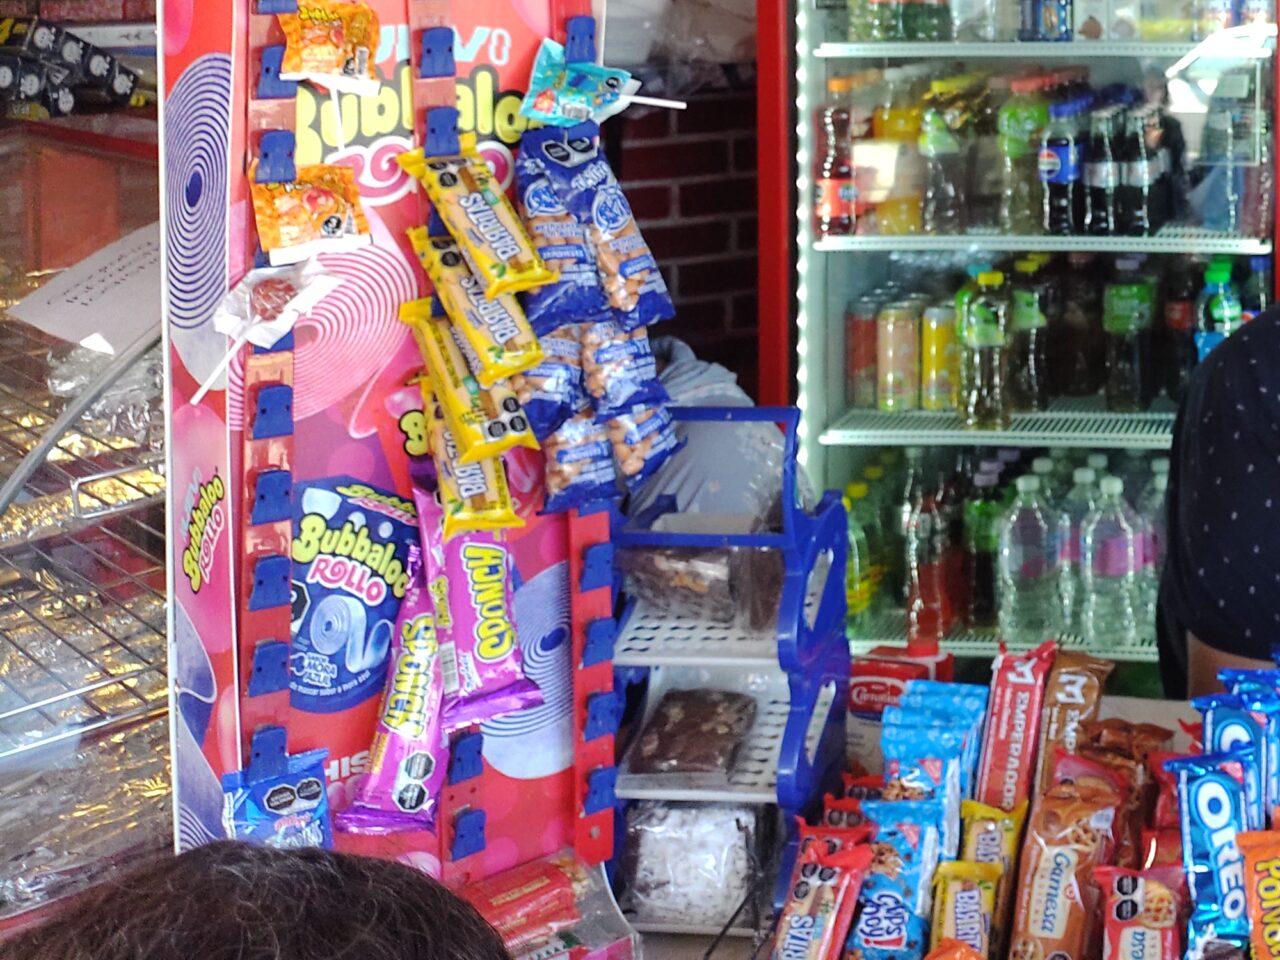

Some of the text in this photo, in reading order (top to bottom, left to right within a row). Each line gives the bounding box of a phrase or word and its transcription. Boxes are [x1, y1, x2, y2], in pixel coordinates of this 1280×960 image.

[459, 191, 522, 262] BARRITAS
[182, 474, 225, 594] Bubbaloo
[199, 504, 226, 585] ROLLO
[291, 511, 410, 599] Bubbaloo
[306, 554, 388, 606] ROLLO
[460, 543, 515, 663] SPONCH
[1003, 691, 1030, 809] EMPERADOR
[1041, 852, 1072, 932] Gamesa
[1197, 781, 1246, 920] OREO
